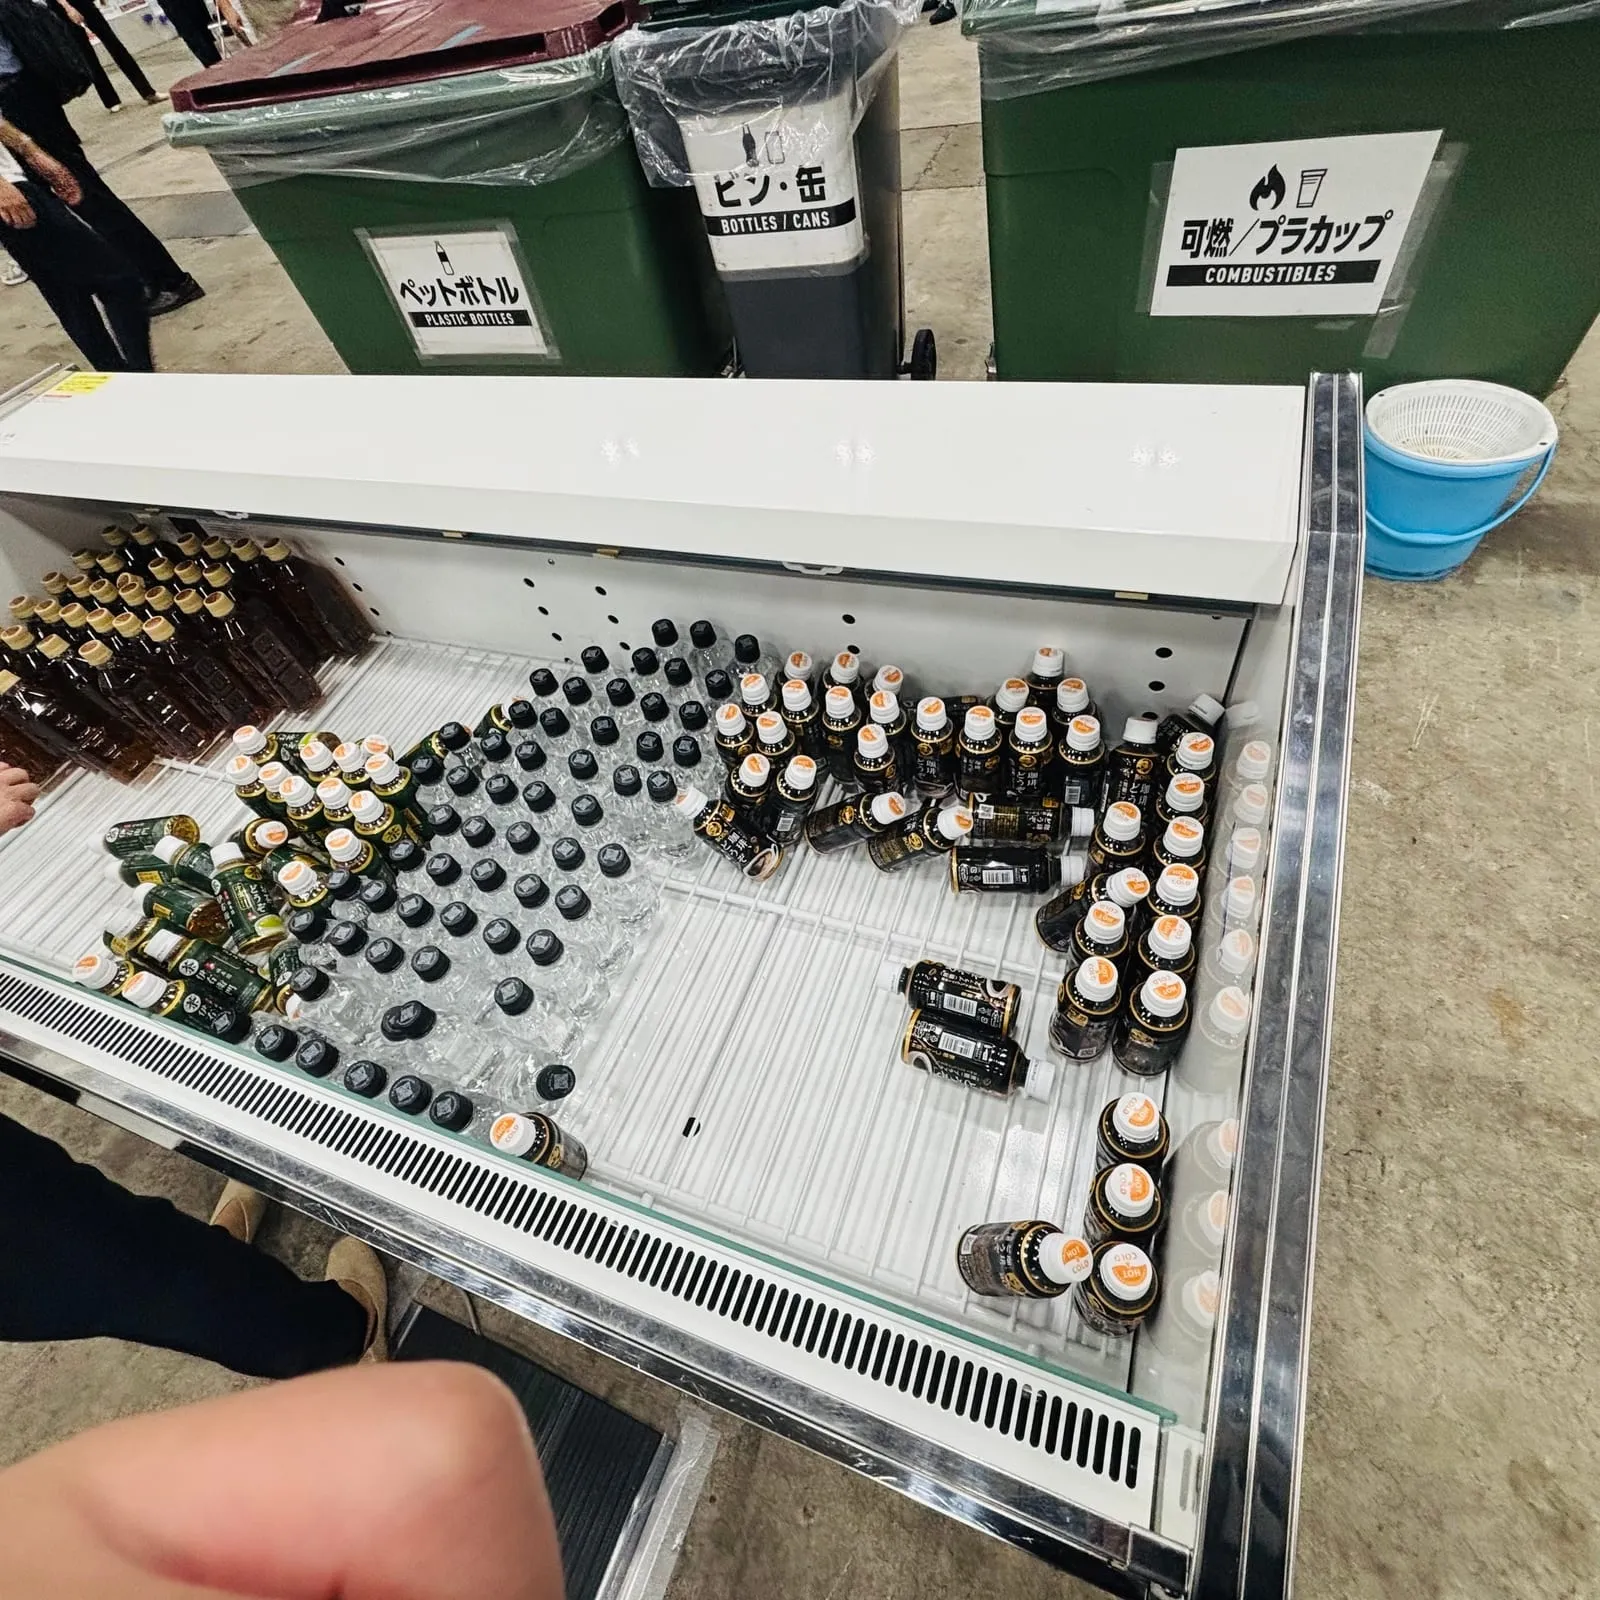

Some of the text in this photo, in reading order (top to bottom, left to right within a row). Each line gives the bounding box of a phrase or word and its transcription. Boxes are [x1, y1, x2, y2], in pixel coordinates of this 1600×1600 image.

[714, 165, 826, 208] ビン・缶
[721, 216, 777, 234] BOTTLES
[793, 211, 831, 229] CANS
[1205, 264, 1337, 283] COMBUSTIBLES
[400, 275, 519, 307] ペットボトル
[425, 312, 514, 326] PLASTIC BOTTLES
[1066, 1246, 1081, 1258] HOT
[1114, 1252, 1138, 1262] COLD
[1072, 1259, 1089, 1274] COLD
[1123, 1269, 1141, 1278] HOT
